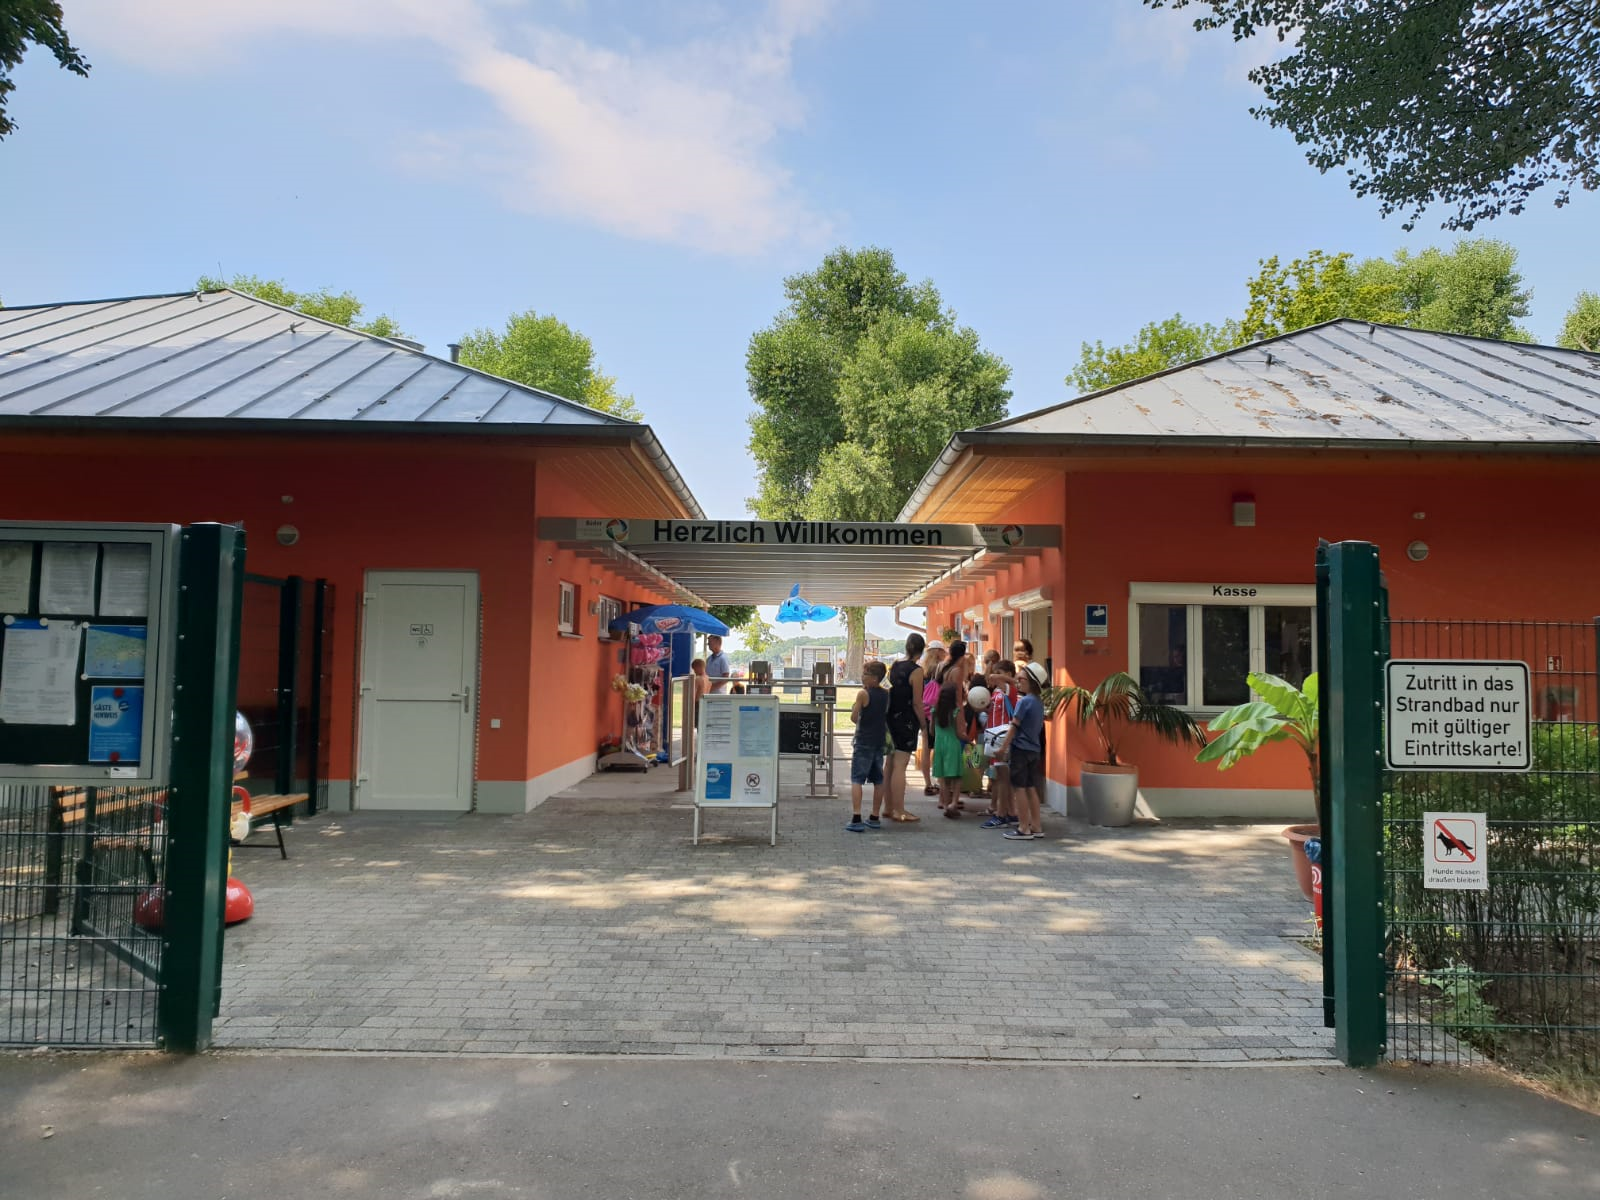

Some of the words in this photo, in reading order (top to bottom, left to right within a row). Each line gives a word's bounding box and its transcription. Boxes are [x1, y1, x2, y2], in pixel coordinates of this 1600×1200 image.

[654, 520, 765, 543] Herzlich
[774, 521, 942, 546] Willkommen
[1212, 585, 1257, 597] Kasse
[1405, 674, 1457, 691] Zutritt
[1462, 674, 1478, 691] in
[1484, 675, 1514, 691] das
[1396, 696, 1484, 712] Strandbad
[1490, 701, 1520, 713] nur
[1411, 718, 1438, 734] mit
[1444, 718, 1511, 738] gültiger
[1405, 740, 1522, 756] Eintrittskarte!
